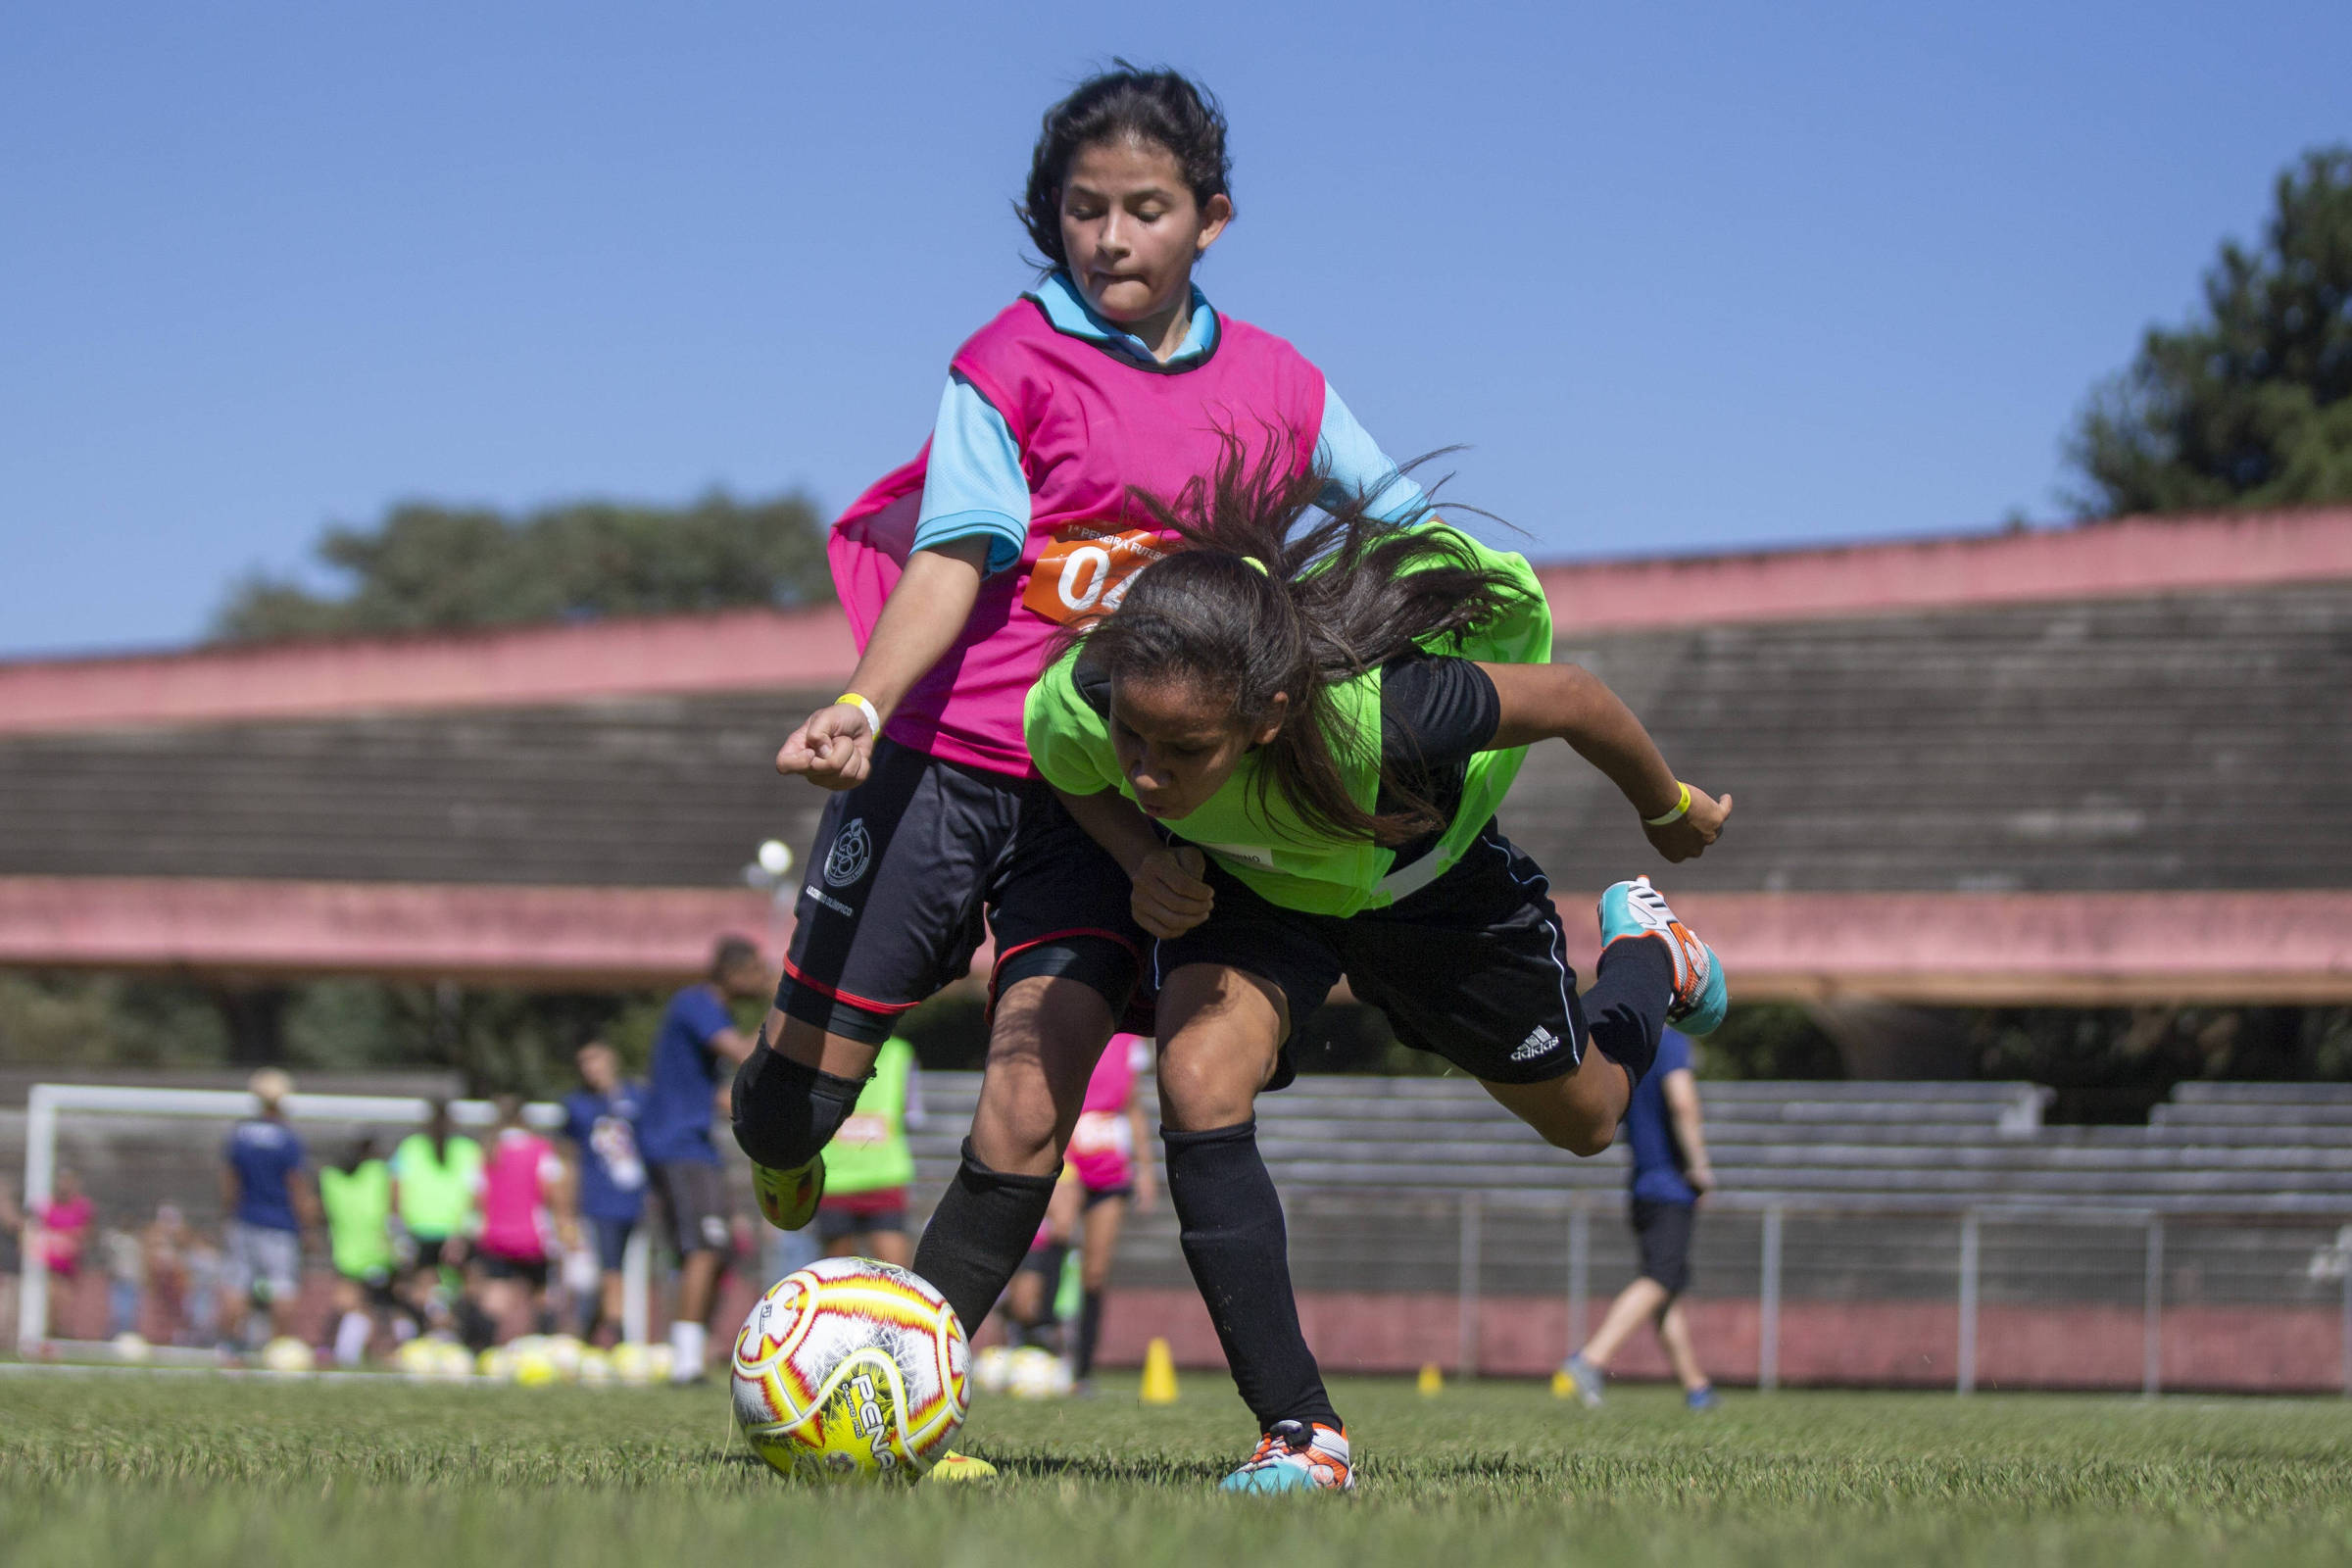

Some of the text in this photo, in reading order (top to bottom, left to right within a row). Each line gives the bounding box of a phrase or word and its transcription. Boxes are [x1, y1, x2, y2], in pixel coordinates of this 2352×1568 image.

[1081, 527, 1129, 550] PENEIRA
[1510, 1036, 1560, 1061] adidas
[841, 1382, 863, 1440] CAMPO PRO
